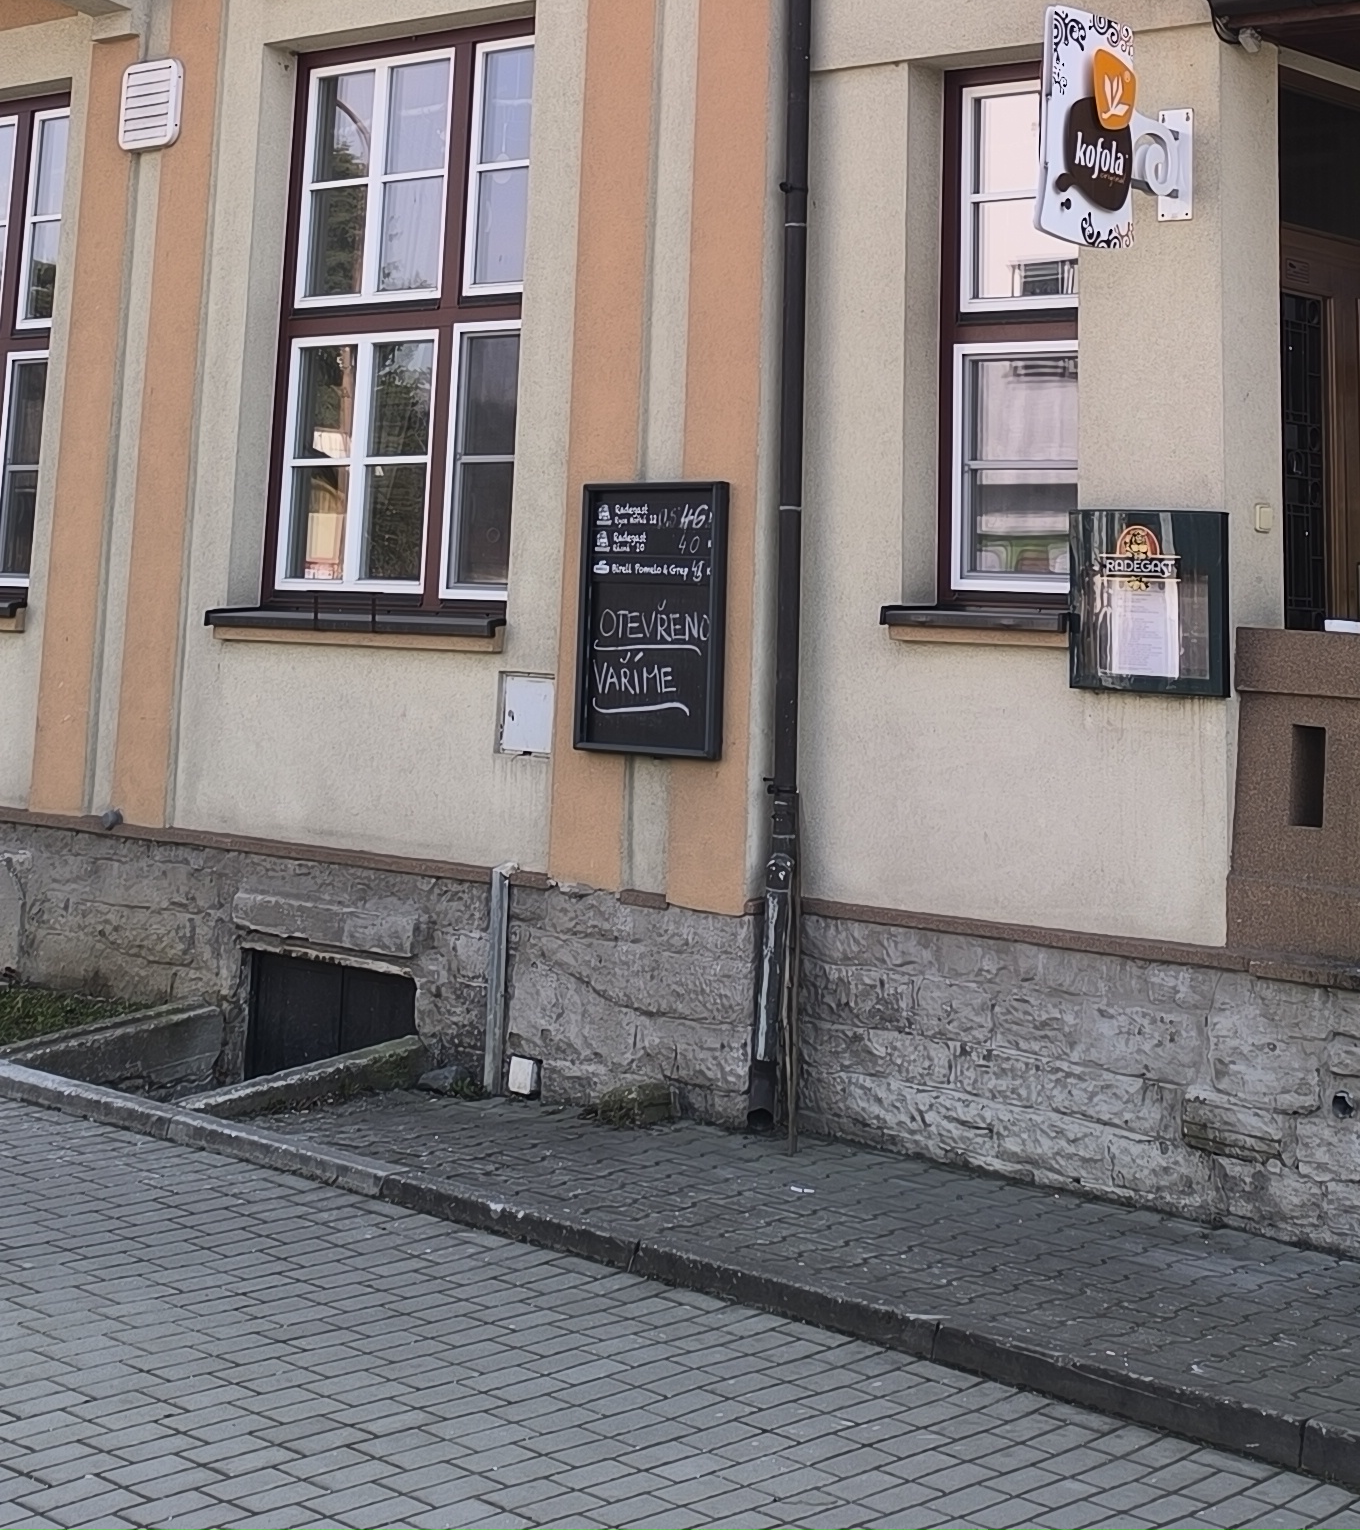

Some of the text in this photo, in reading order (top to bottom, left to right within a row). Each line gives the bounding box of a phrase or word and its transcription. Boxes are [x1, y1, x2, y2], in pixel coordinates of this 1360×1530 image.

[1074, 131, 1124, 179] kofola
[615, 502, 649, 518] Radegast
[613, 530, 647, 546] Radegast
[679, 532, 700, 554] 40
[611, 563, 632, 574] Birell
[634, 563, 662, 575] Pomelo
[669, 564, 688, 581] Grep
[1106, 559, 1175, 578] RADEGAST
[600, 599, 710, 642] OTEVŘENO
[593, 651, 677, 694] VAŘÍME
